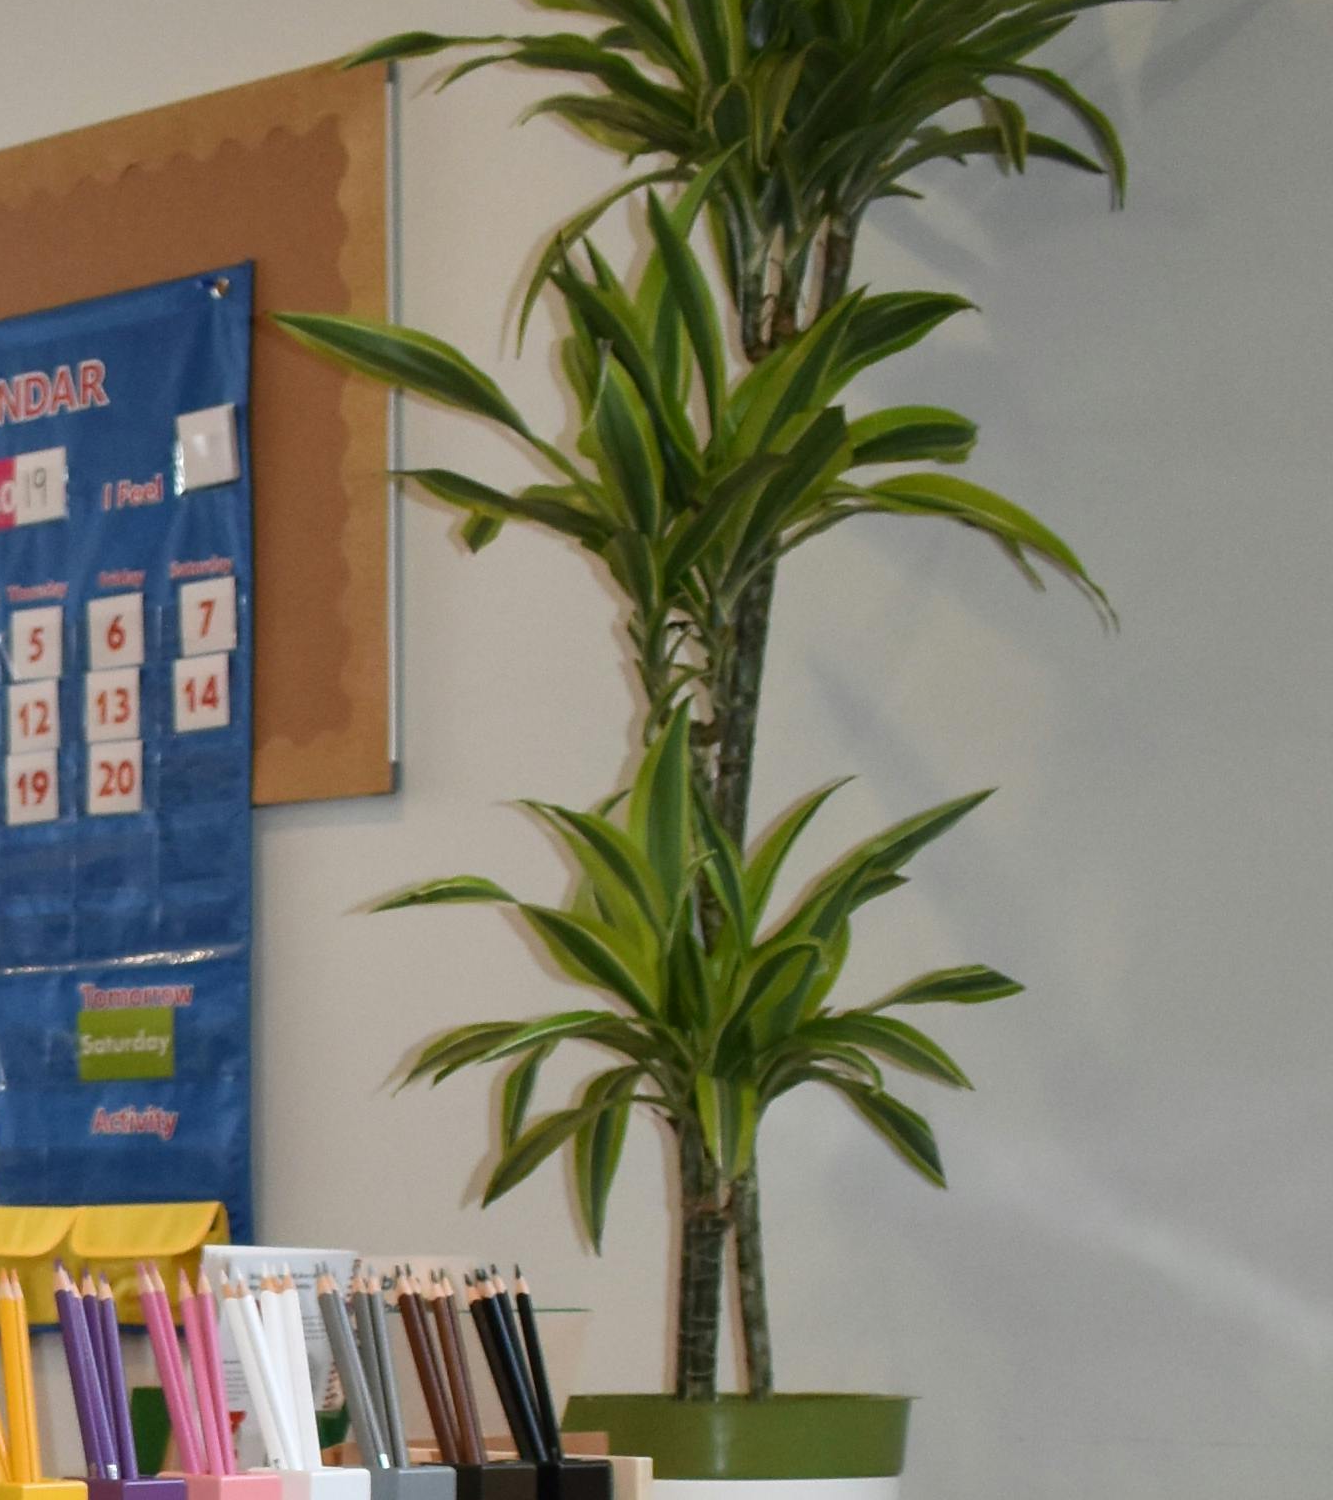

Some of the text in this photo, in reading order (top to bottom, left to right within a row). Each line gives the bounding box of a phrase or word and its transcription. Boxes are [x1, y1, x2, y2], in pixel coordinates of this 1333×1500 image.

[117, 473, 164, 508] Feel
[29, 627, 44, 663] 5
[107, 614, 125, 651] 6
[199, 600, 216, 639] 7
[18, 700, 51, 738] 12
[96, 687, 131, 725] 13
[185, 675, 220, 713] 14
[17, 770, 50, 807] 19
[99, 760, 135, 798] 20
[78, 983, 194, 1011] Tomorrow
[80, 1029, 170, 1056] Saturday
[91, 1105, 179, 1141] Activity
